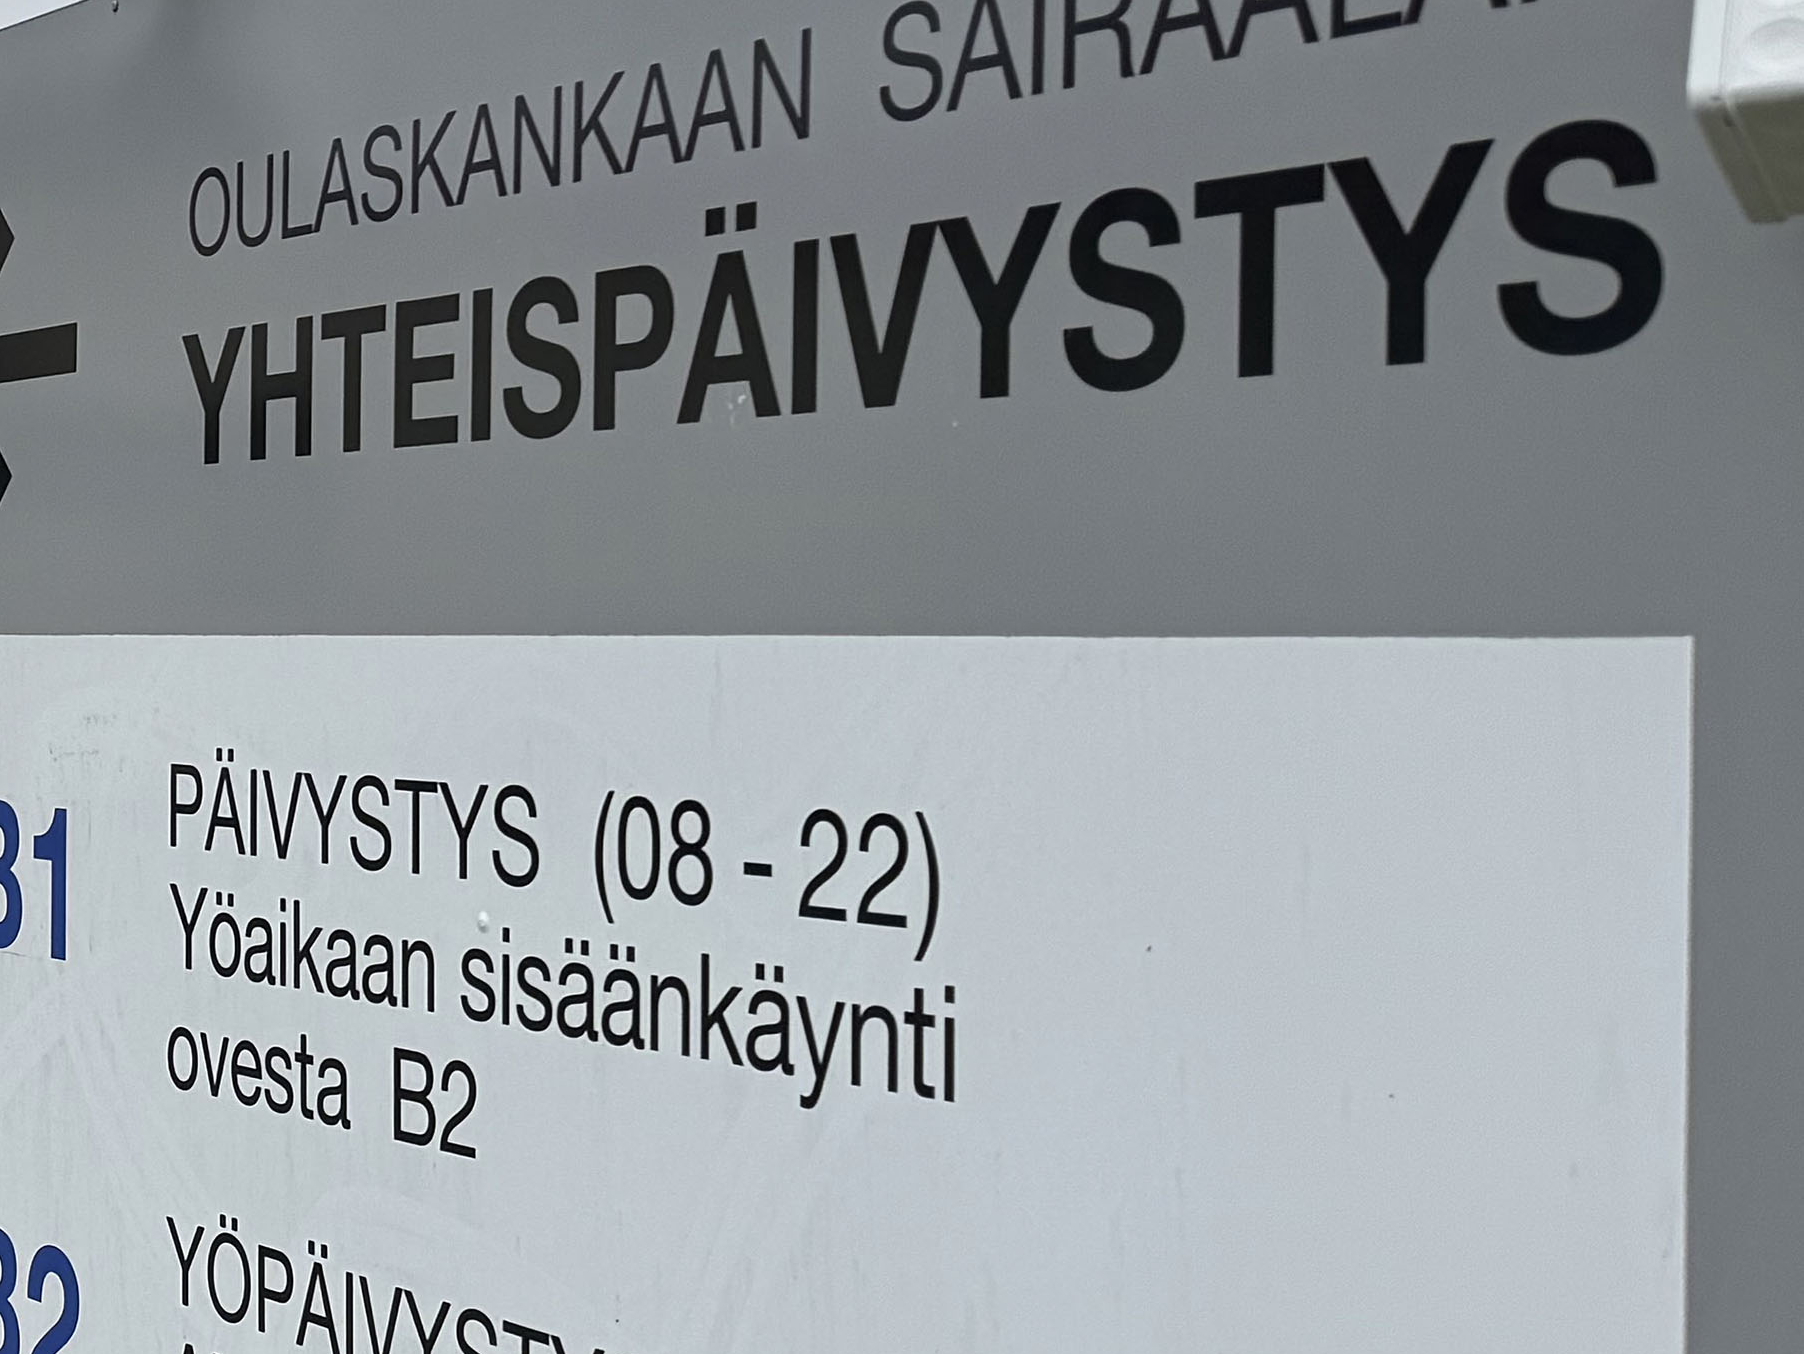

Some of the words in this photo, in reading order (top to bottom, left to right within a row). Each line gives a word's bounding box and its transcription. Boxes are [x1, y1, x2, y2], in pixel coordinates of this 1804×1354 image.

[190, 29, 810, 256] OULASKANKAAN
[183, 120, 1662, 464] YHTEISPÄIVYSTYS
[171, 748, 539, 887] PÄIVYSTYS
[168, 1027, 350, 1129] ovesta
[394, 1048, 476, 1158] B2
[170, 884, 434, 1012] Yöaikaan
[461, 928, 954, 1109] sisäänkäynti
